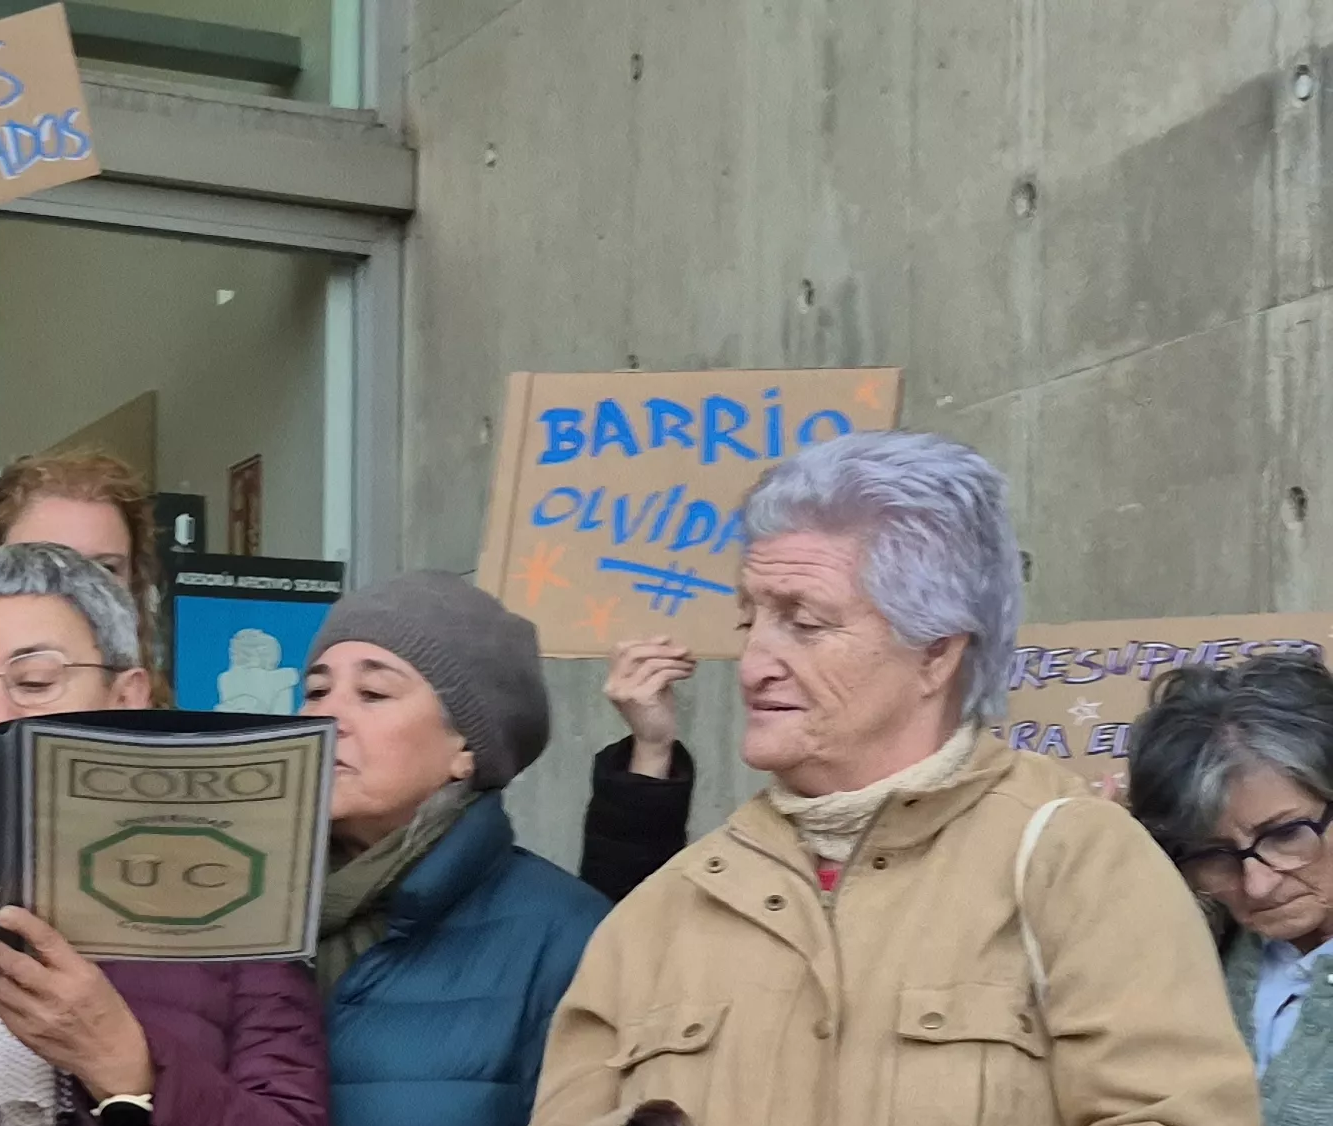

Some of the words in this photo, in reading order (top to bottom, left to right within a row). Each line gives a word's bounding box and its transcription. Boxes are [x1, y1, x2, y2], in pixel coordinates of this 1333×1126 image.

[989, 720, 1071, 758] RA
[81, 766, 273, 799] CORO
[115, 859, 162, 887] U
[181, 862, 229, 888] C
